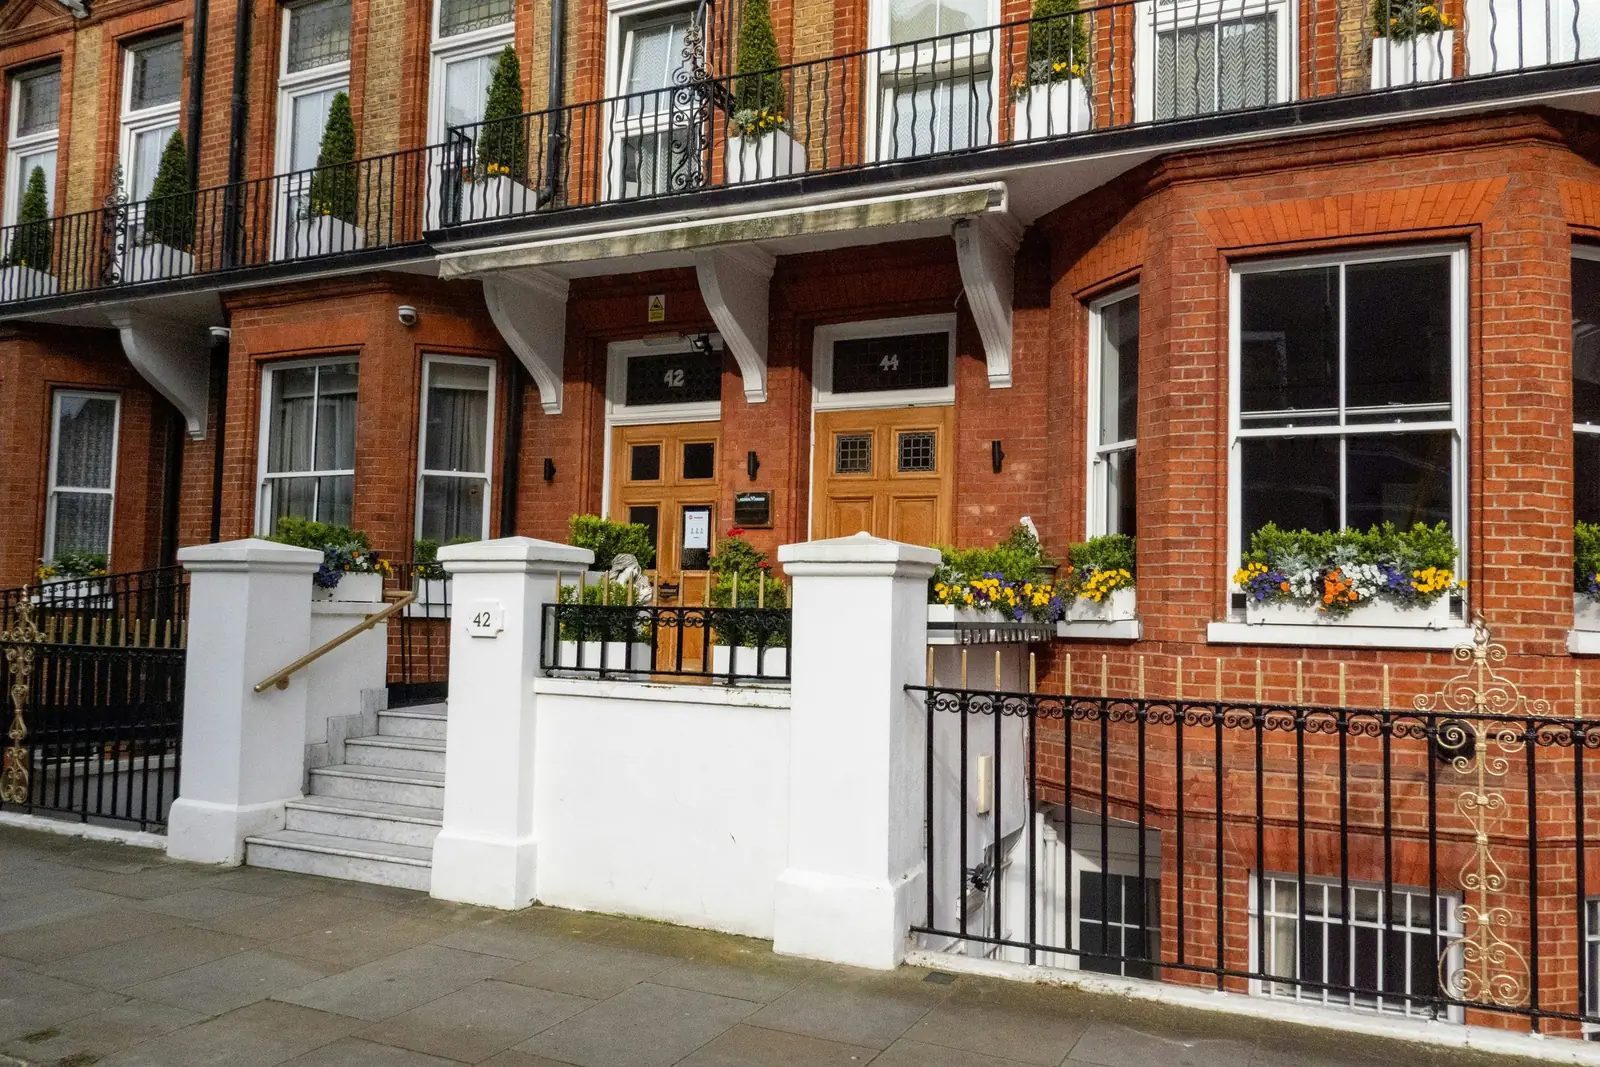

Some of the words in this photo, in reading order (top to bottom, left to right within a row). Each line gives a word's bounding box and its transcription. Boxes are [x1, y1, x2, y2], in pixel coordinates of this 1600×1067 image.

[880, 354, 899, 371] 44
[664, 369, 684, 388] 42
[473, 611, 491, 627] 42
